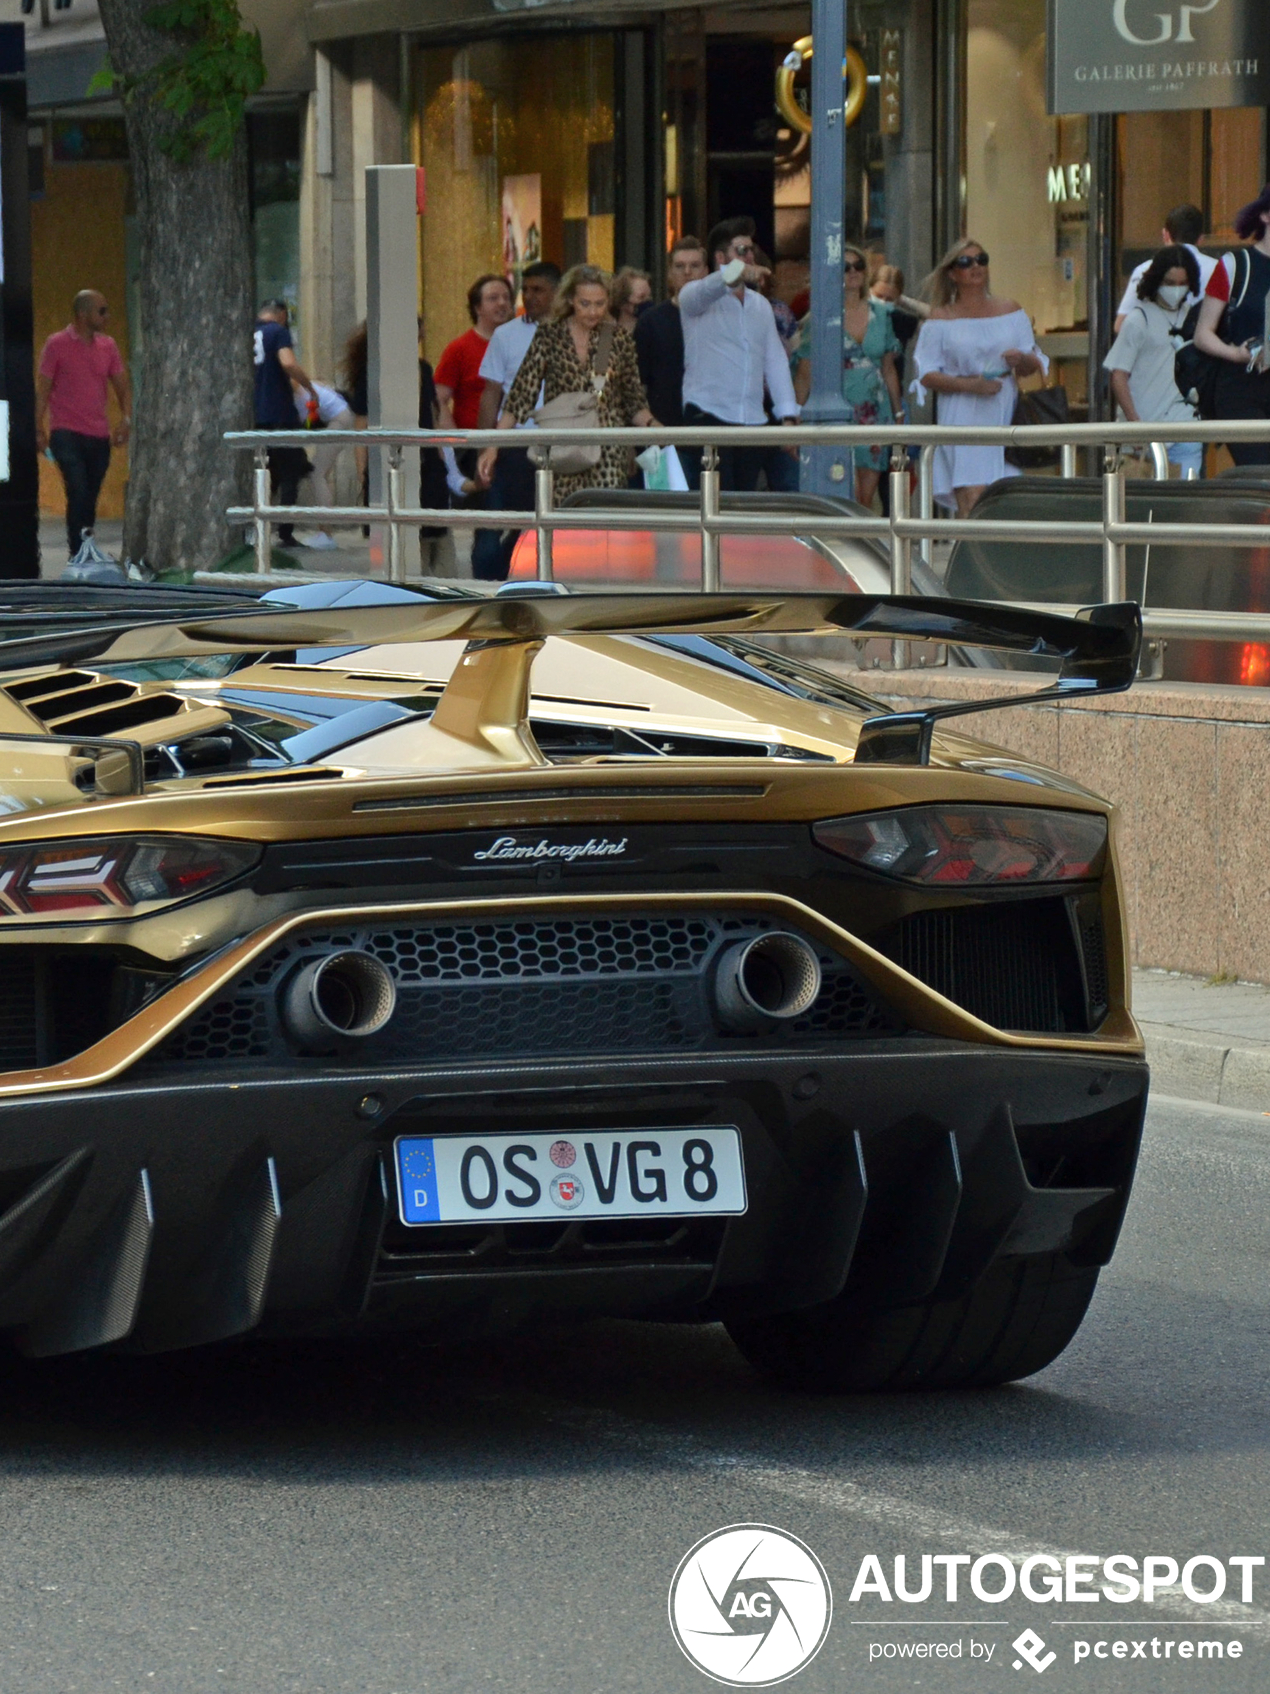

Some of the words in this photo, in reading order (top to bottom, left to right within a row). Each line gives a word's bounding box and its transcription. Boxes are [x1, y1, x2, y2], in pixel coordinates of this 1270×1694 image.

[1074, 63, 1156, 82] GALERIE
[1162, 59, 1259, 78] PAFFRATH
[474, 836, 629, 862] Lamborghini
[460, 1144, 542, 1210] OS
[583, 1141, 668, 1204] VG
[682, 1138, 718, 1202] 8
[414, 1188, 428, 1208] D
